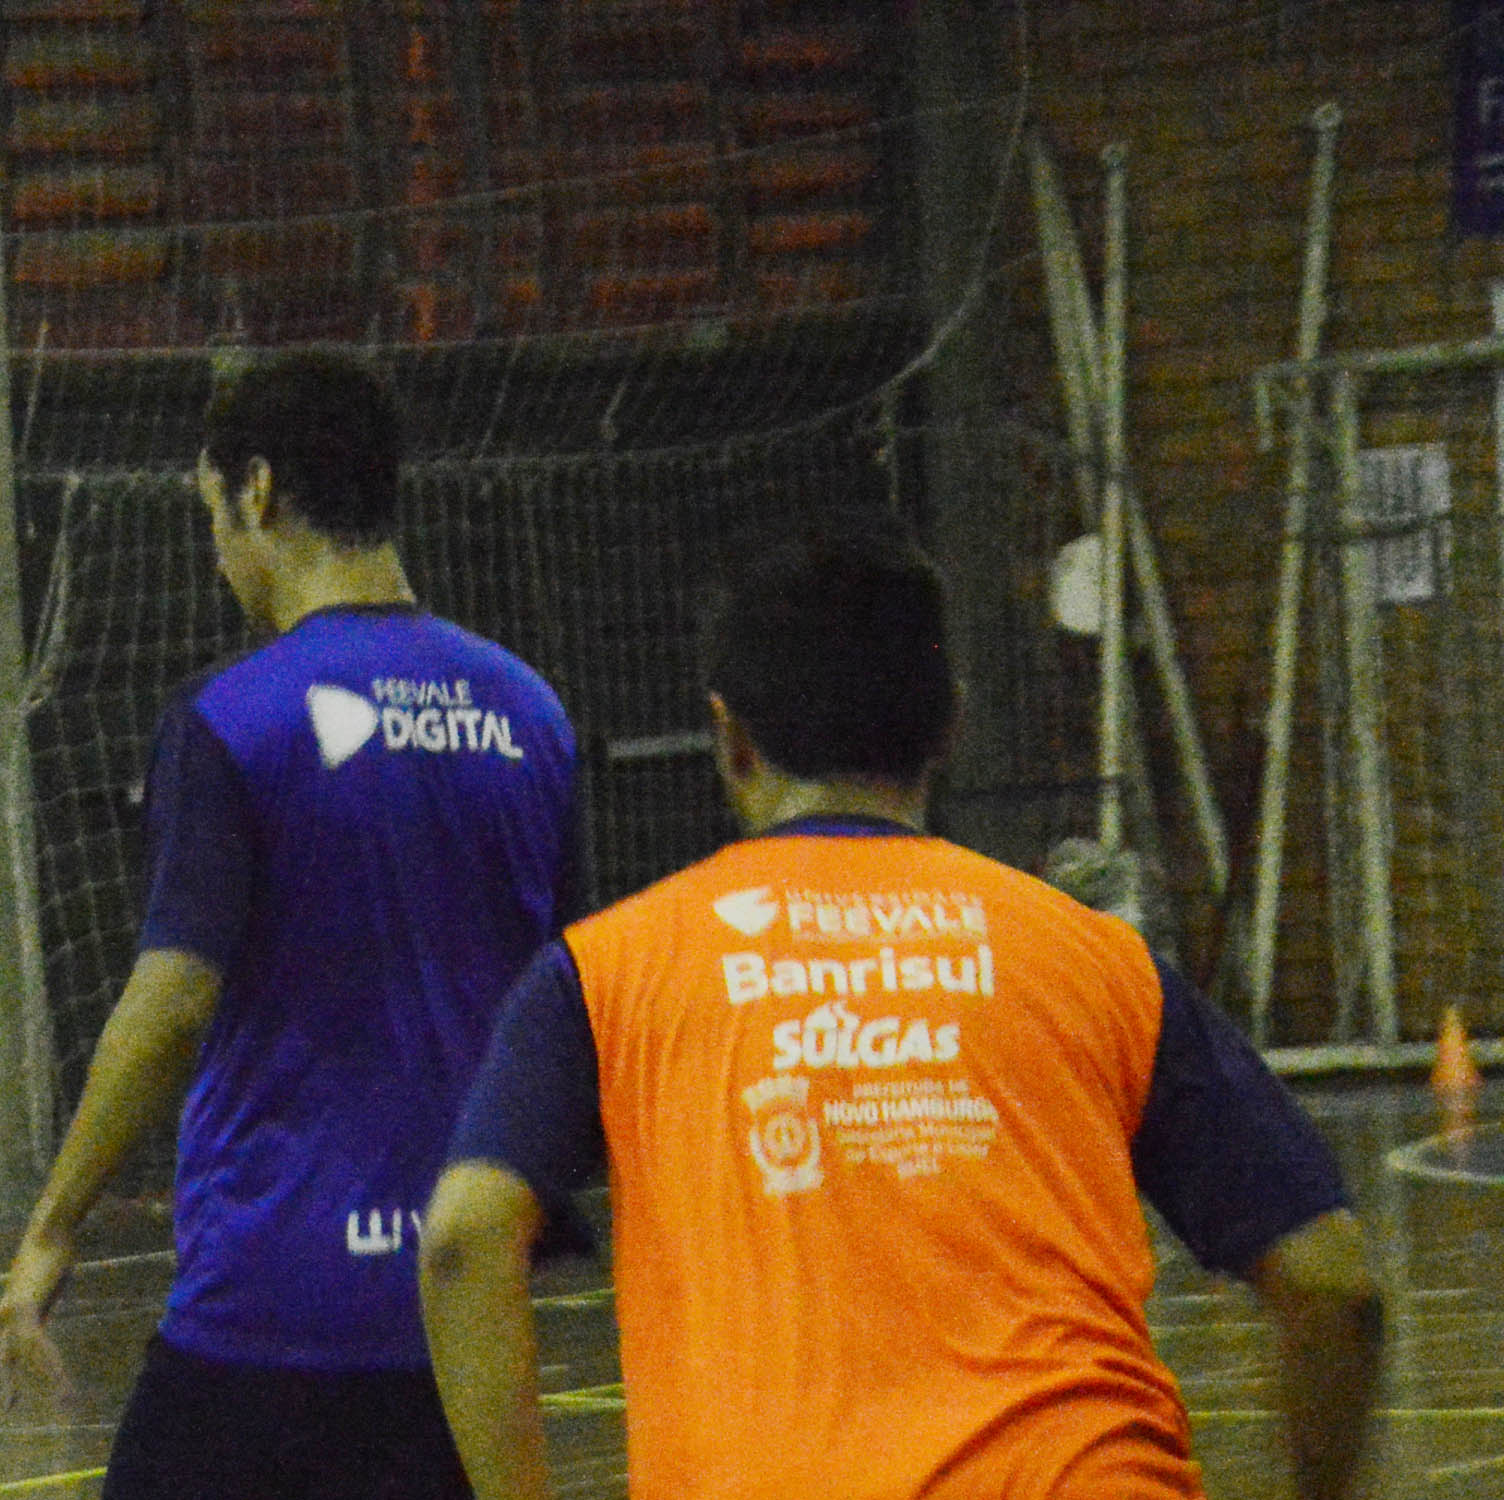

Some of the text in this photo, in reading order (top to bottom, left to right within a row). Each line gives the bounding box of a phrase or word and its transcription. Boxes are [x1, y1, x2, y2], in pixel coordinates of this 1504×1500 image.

[383, 708, 524, 760] DIGITAL
[787, 900, 988, 936] FEEVALE
[722, 944, 994, 1006] Banrisul
